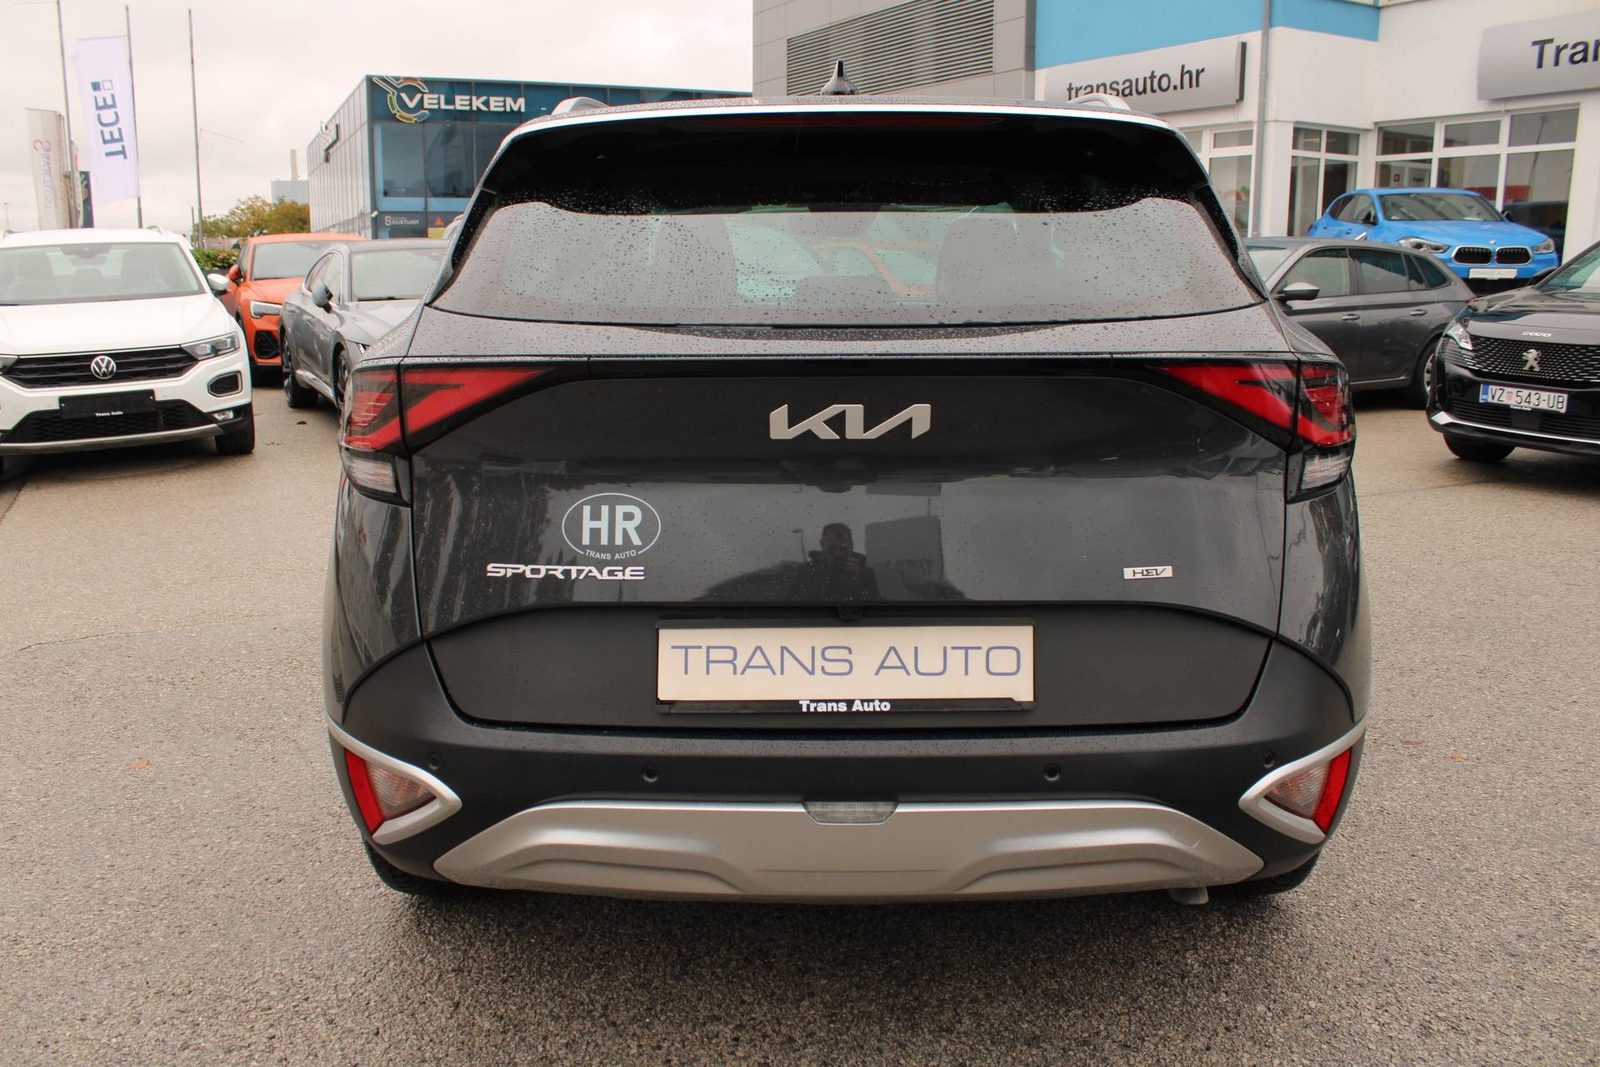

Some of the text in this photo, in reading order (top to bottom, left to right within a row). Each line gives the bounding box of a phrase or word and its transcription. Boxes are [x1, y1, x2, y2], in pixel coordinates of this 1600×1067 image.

[1067, 64, 1205, 100] transauto.hr
[400, 93, 525, 113] VELEKEM
[1490, 387, 1565, 410] VZ 543-UB
[769, 404, 931, 439] KIA
[581, 505, 643, 546] HR
[585, 549, 637, 560] TRANS AUTO
[486, 563, 645, 580] SPORTAGE
[1130, 567, 1168, 577] HEV
[671, 645, 1022, 677] TRANS AUTO
[799, 700, 891, 713] Trans Auto
